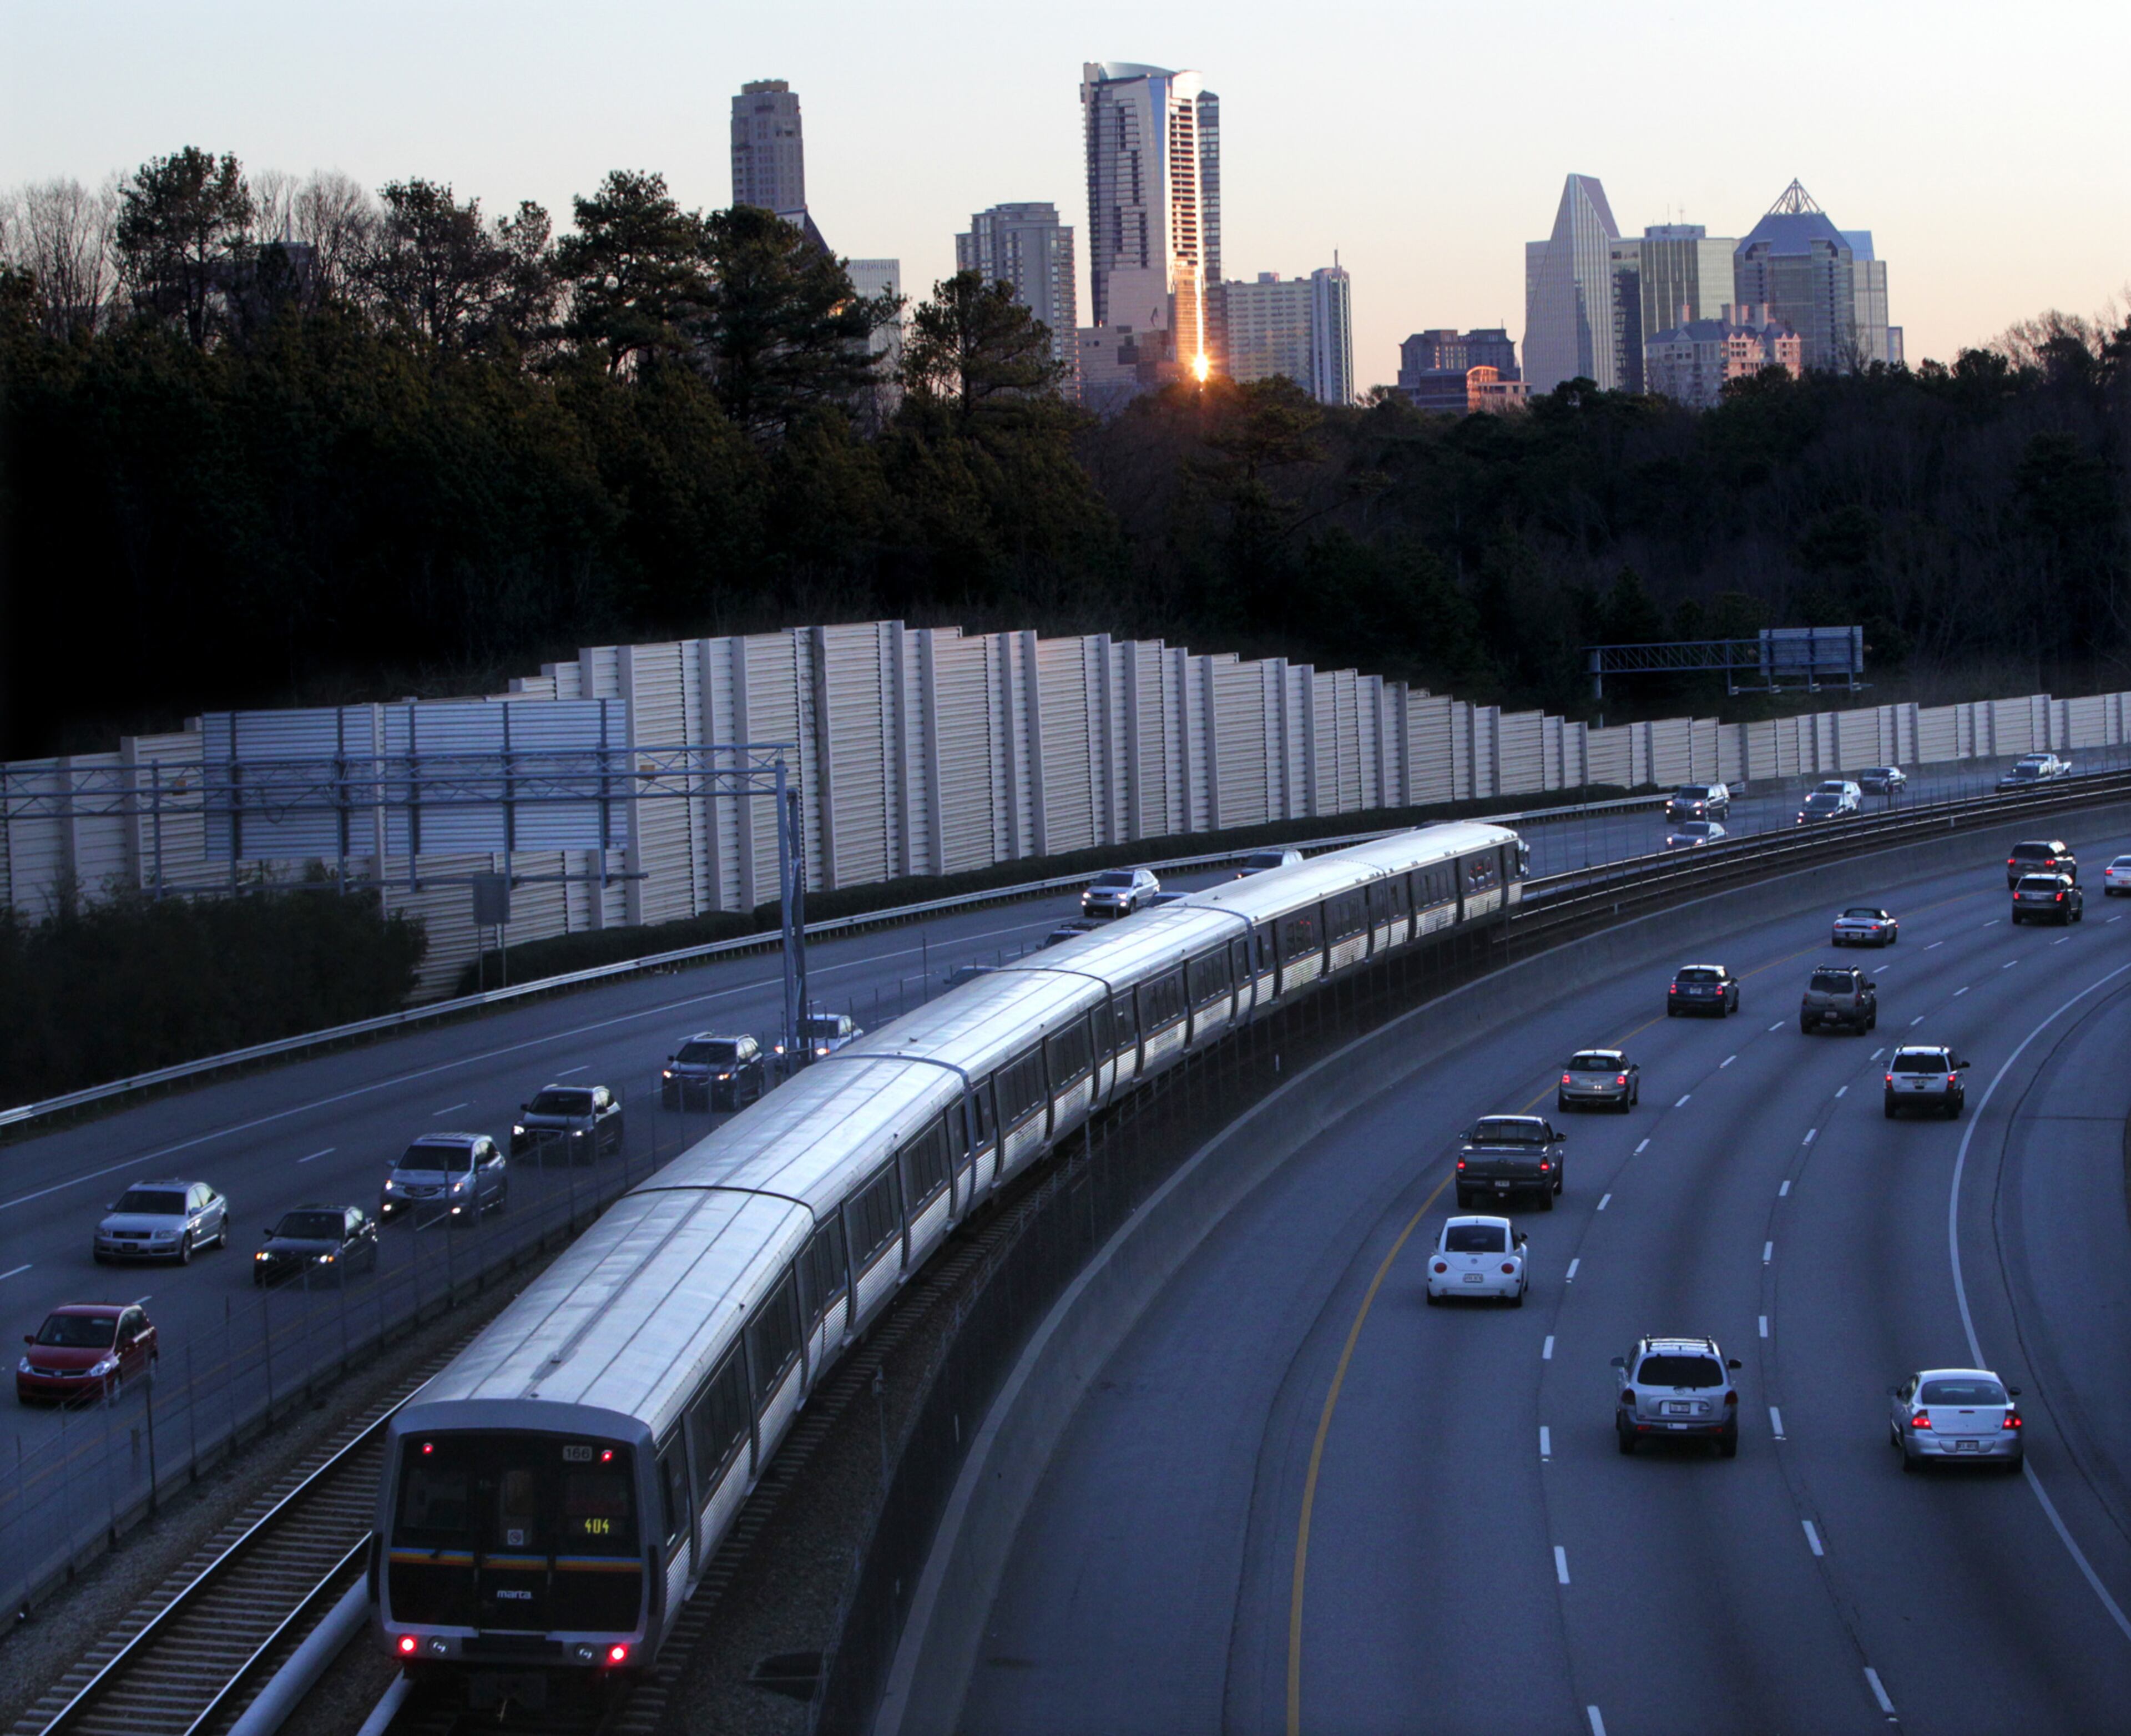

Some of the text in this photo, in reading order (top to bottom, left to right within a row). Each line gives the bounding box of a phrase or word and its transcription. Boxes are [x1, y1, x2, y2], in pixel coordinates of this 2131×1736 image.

[567, 1447, 590, 1459] 166
[585, 1518, 609, 1533] 404
[497, 1590, 531, 1599] marta
